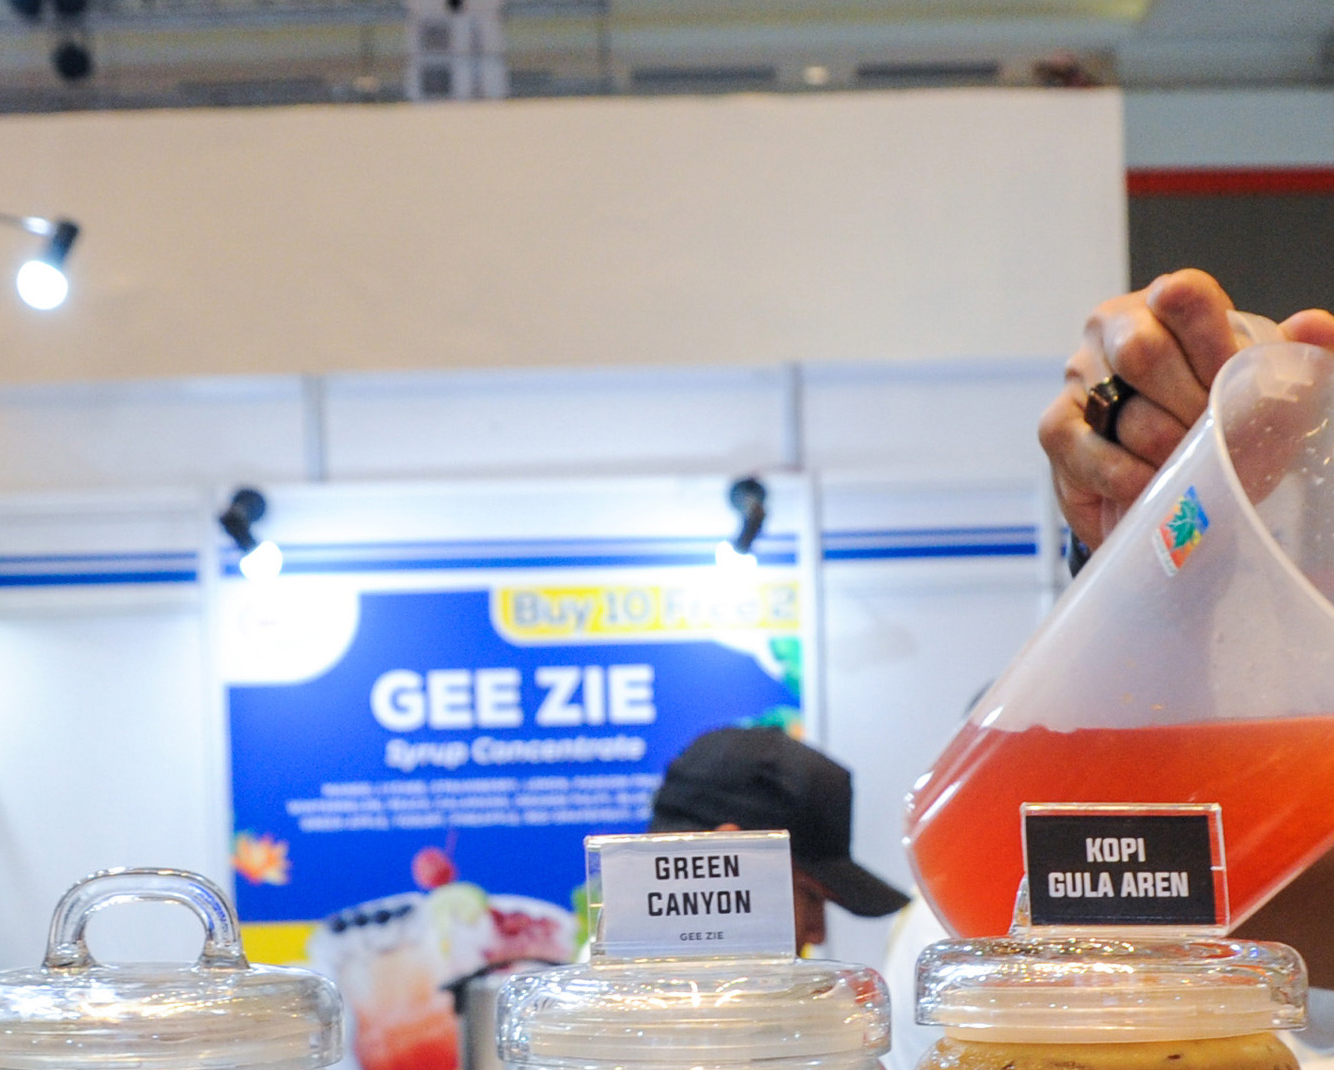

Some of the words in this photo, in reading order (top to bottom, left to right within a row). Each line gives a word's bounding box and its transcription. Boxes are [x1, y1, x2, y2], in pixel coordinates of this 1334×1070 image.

[512, 590, 593, 635] Buy
[606, 588, 651, 625] 10
[370, 668, 524, 732] GEE
[534, 664, 656, 727] ZIE
[384, 738, 468, 772] Syrup
[471, 734, 646, 765] Concentrate
[1085, 837, 1147, 863] KOPI
[655, 854, 740, 880] GREEN
[1048, 872, 1115, 898] GULA
[1120, 872, 1189, 898] AREN
[647, 890, 751, 917] CANYON
[679, 932, 702, 941] GEE
[706, 931, 724, 940] ZIE
